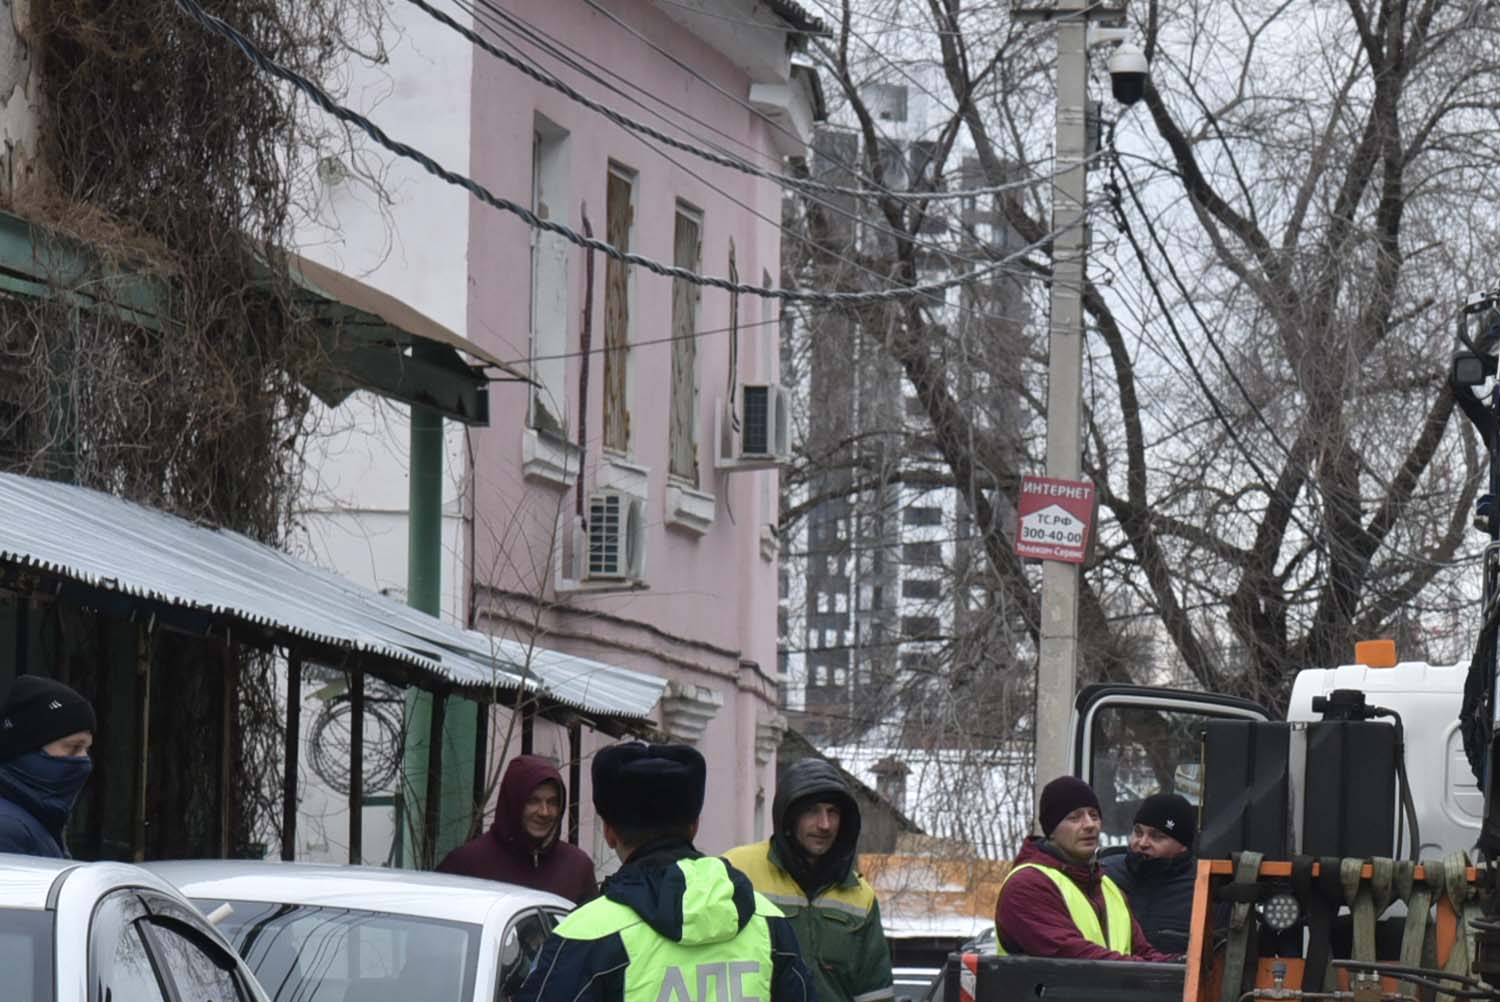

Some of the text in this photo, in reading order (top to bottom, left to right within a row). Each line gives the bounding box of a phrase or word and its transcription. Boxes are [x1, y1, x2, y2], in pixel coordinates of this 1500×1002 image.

[1023, 481, 1091, 500] ИНТЕРНЕТ
[1037, 513, 1072, 527] ТС.РФ
[1023, 526, 1082, 543] 300-40-00
